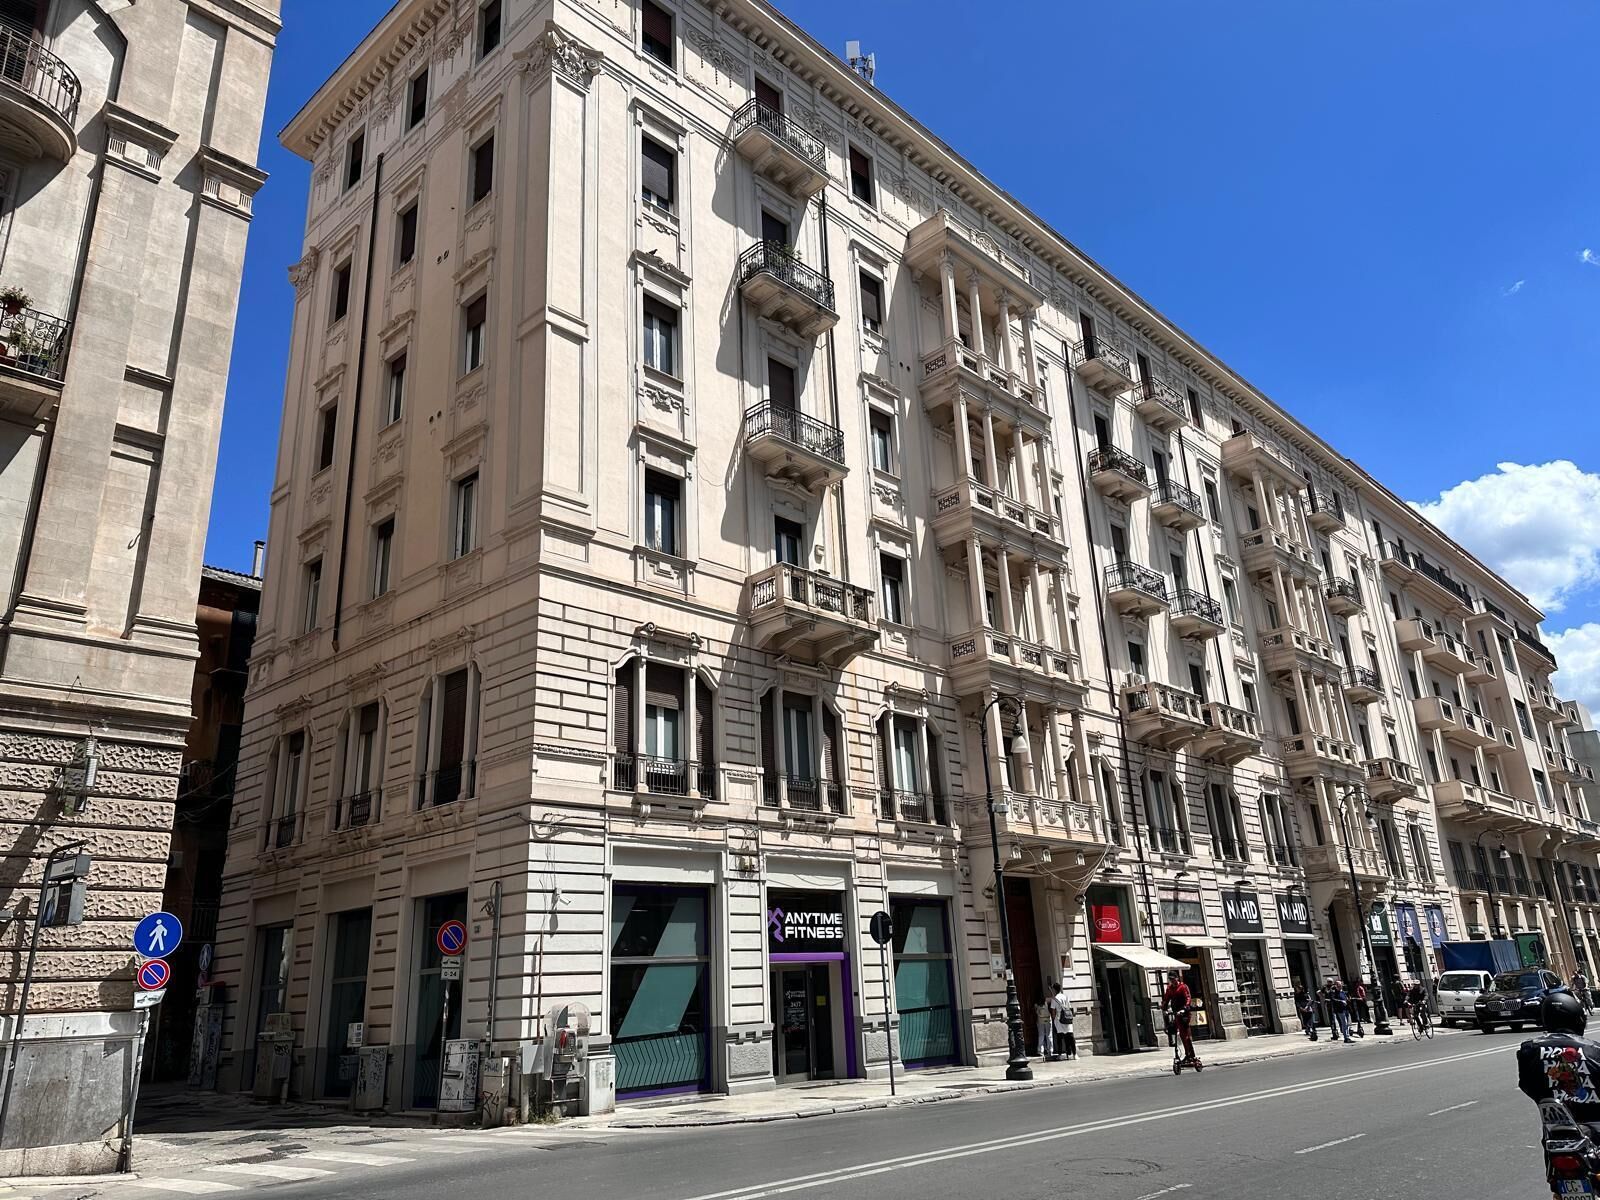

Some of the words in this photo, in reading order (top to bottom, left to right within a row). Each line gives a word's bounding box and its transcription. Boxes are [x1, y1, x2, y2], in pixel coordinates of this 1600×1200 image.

[1226, 899, 1258, 920] NAHID
[1280, 902, 1307, 921] NAHID
[784, 912, 843, 925] ANYTIME
[784, 926, 844, 939] FITNESS
